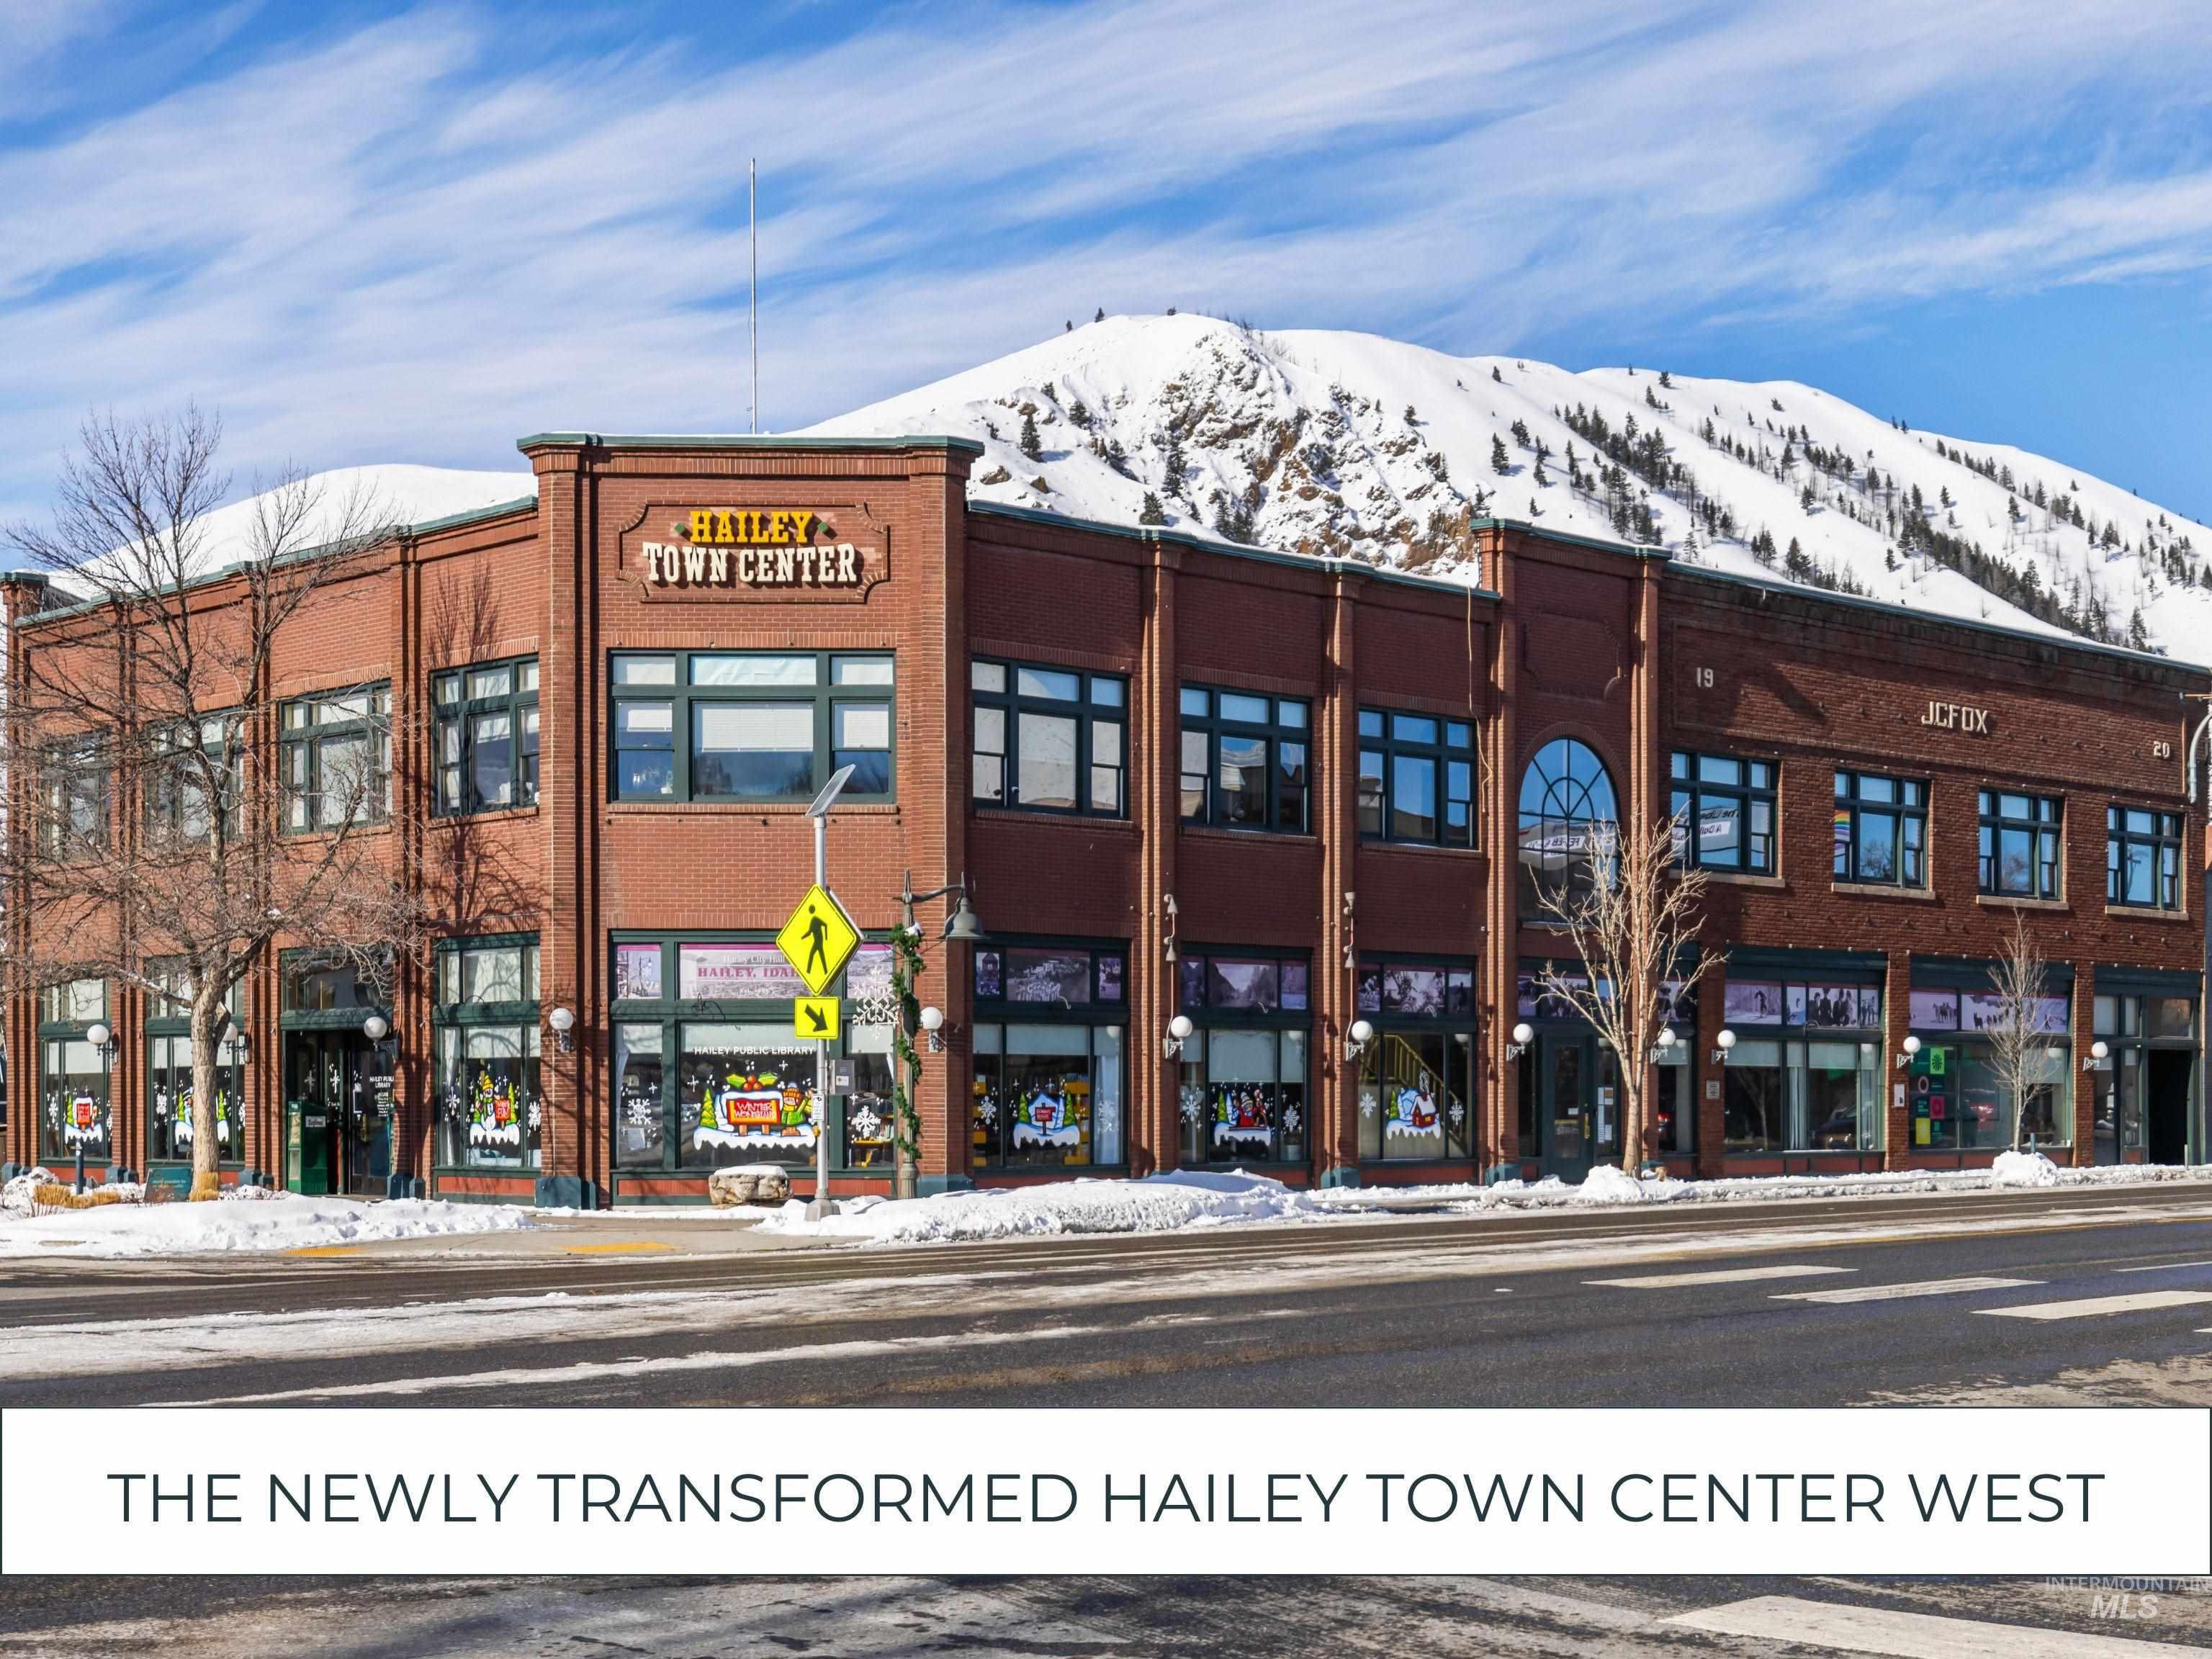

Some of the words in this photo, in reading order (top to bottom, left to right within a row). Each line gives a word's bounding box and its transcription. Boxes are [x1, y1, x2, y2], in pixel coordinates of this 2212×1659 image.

[690, 511, 813, 544] HAILEY
[642, 541, 729, 583] TOWN
[738, 542, 858, 583] CENTER
[1696, 667, 1714, 688] 19
[2154, 740, 2170, 759] 20
[723, 955, 749, 965] Hailey
[751, 955, 767, 965] City
[763, 967, 799, 977] IDAH
[694, 1046, 731, 1055] HAILEY
[733, 1046, 769, 1055] PUBLIC
[771, 1046, 814, 1055] LIBRARY
[736, 1101, 773, 1112] WINTER
